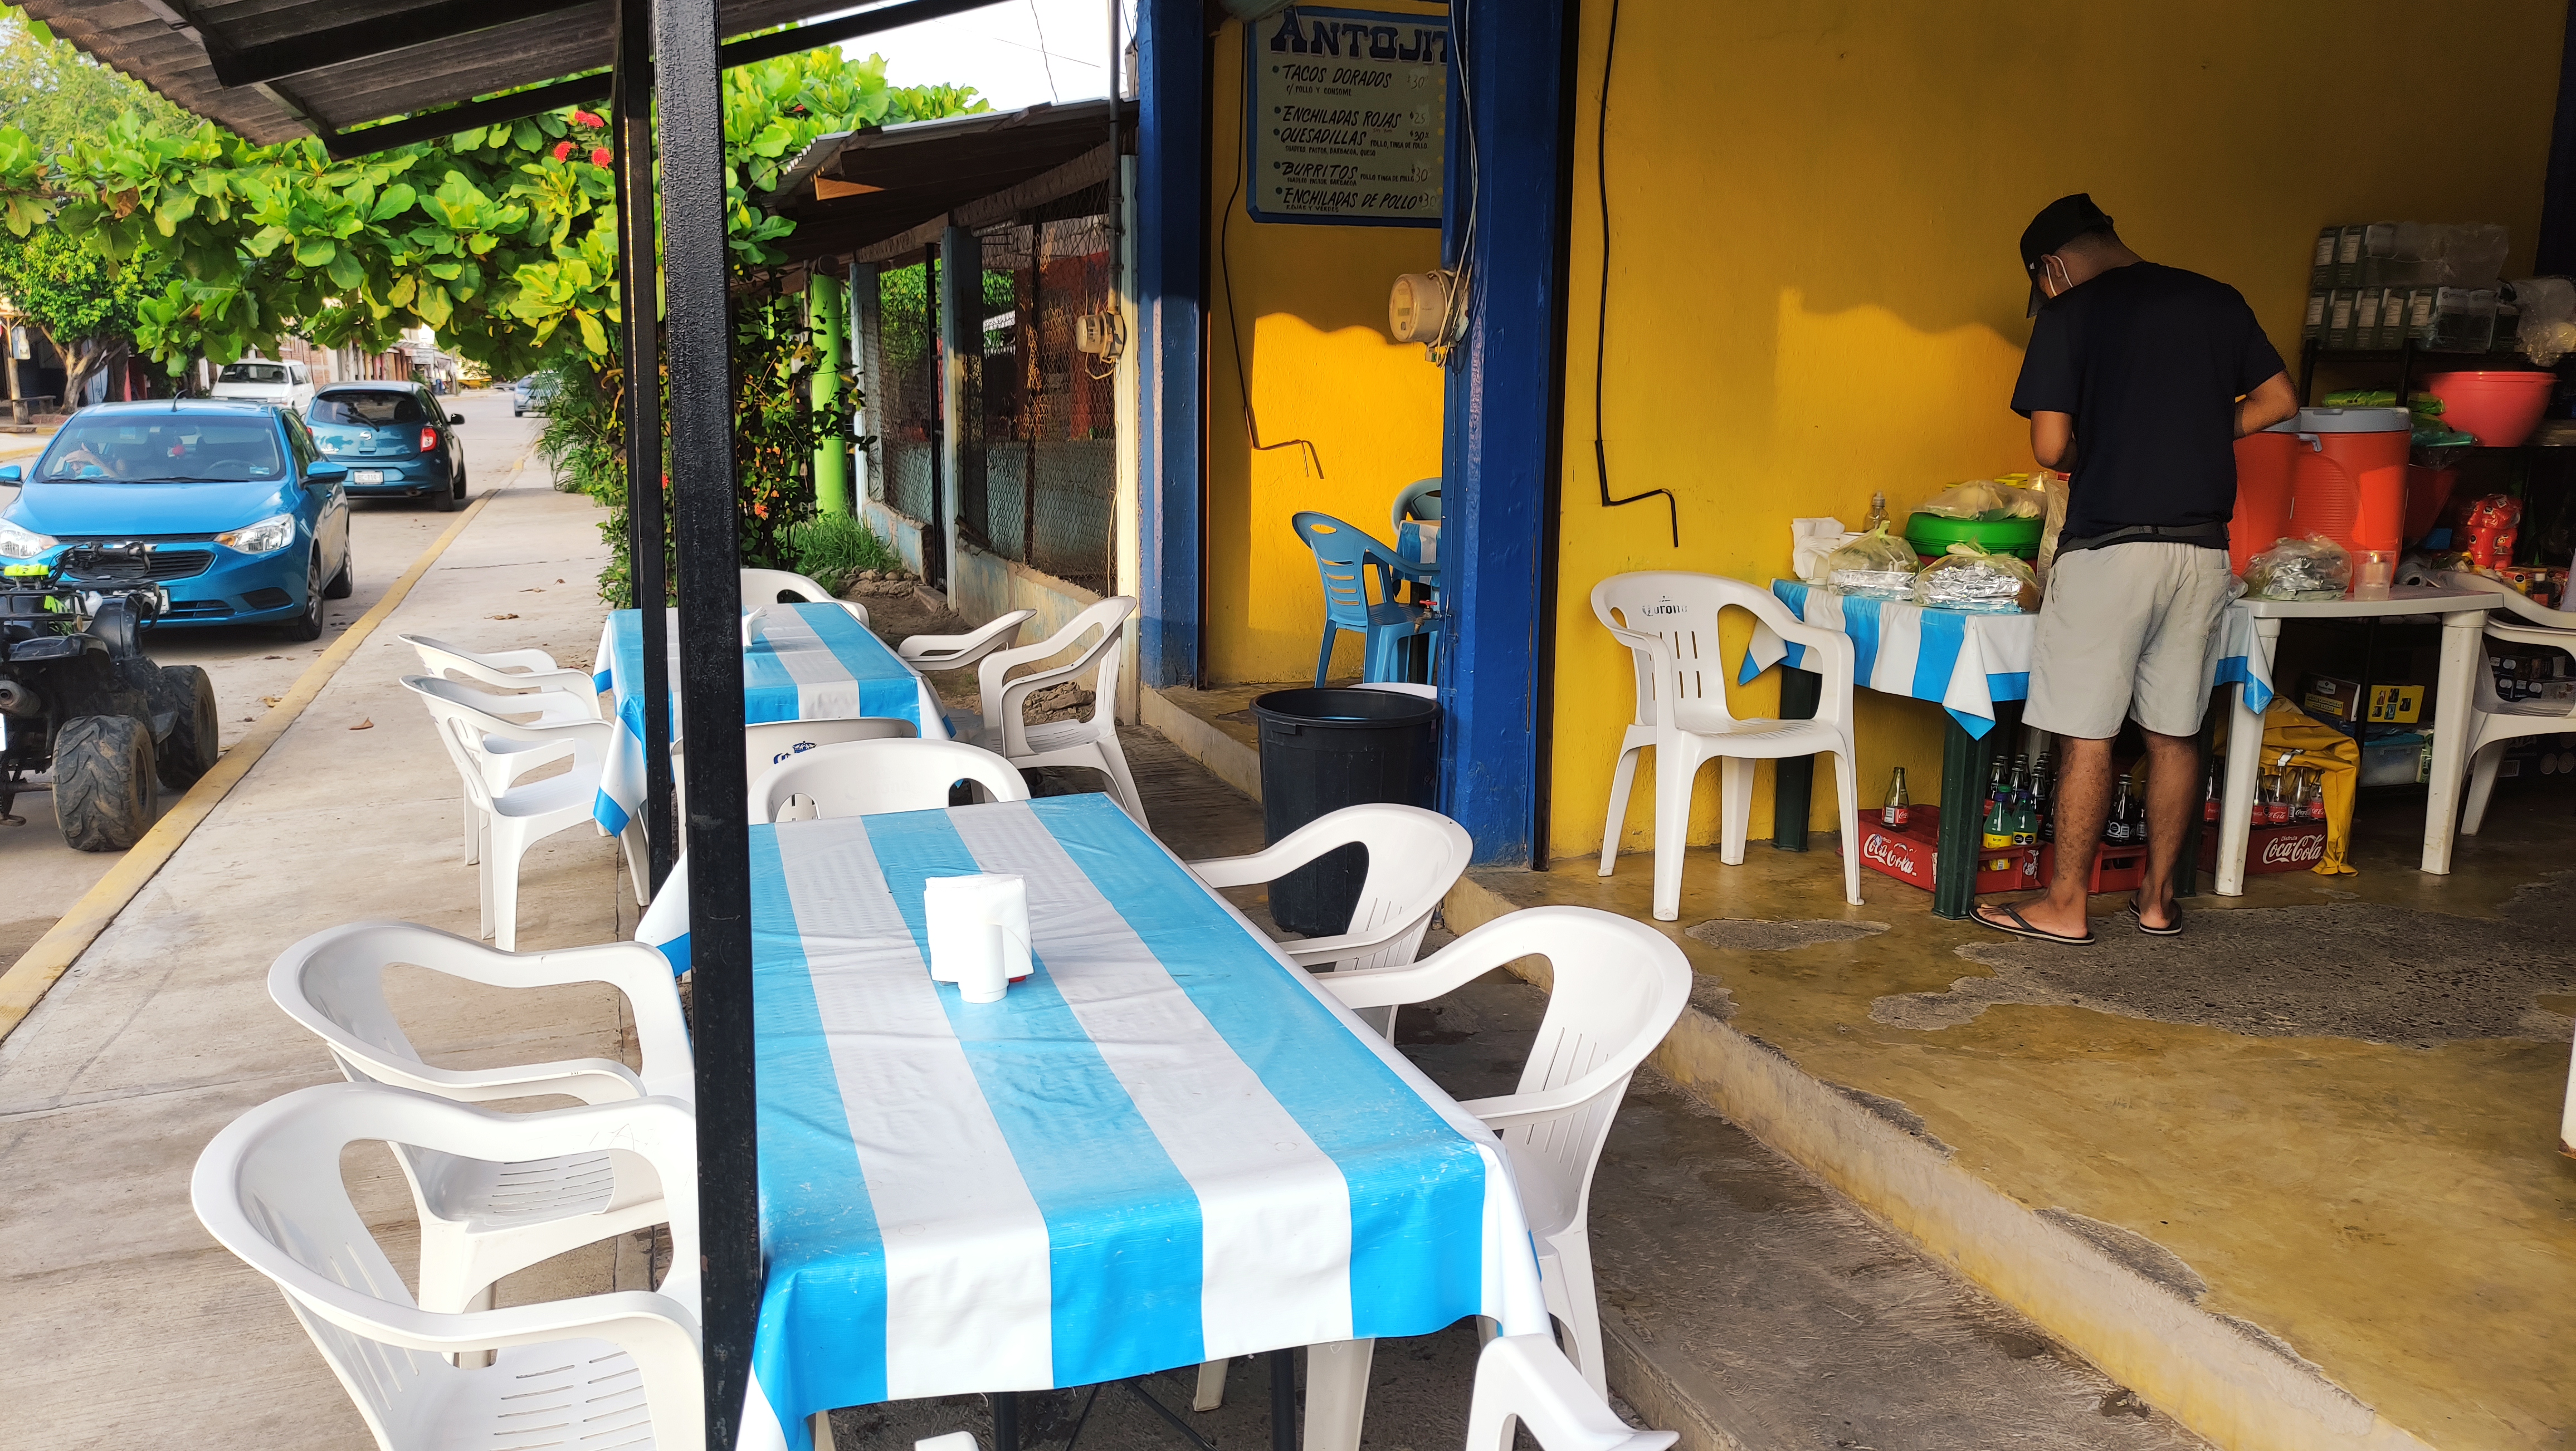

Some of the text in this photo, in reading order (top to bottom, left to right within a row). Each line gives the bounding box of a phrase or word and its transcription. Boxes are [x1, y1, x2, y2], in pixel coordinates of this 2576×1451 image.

[1282, 64, 1327, 82] TACOS
[1332, 68, 1392, 88] DORADOS
[1295, 85, 1313, 93] POLLO
[1282, 105, 1359, 126] ENCHILADAS
[1363, 111, 1402, 128] ROJAS
[1280, 128, 1367, 146] QUESADILLAS
[1282, 162, 1358, 179] BURRITOS
[1284, 188, 1358, 208] ENCHILADAS
[1361, 193, 1379, 208] DE
[1379, 193, 1418, 210] POLLO
[2262, 834, 2326, 864] Coca-Cola
